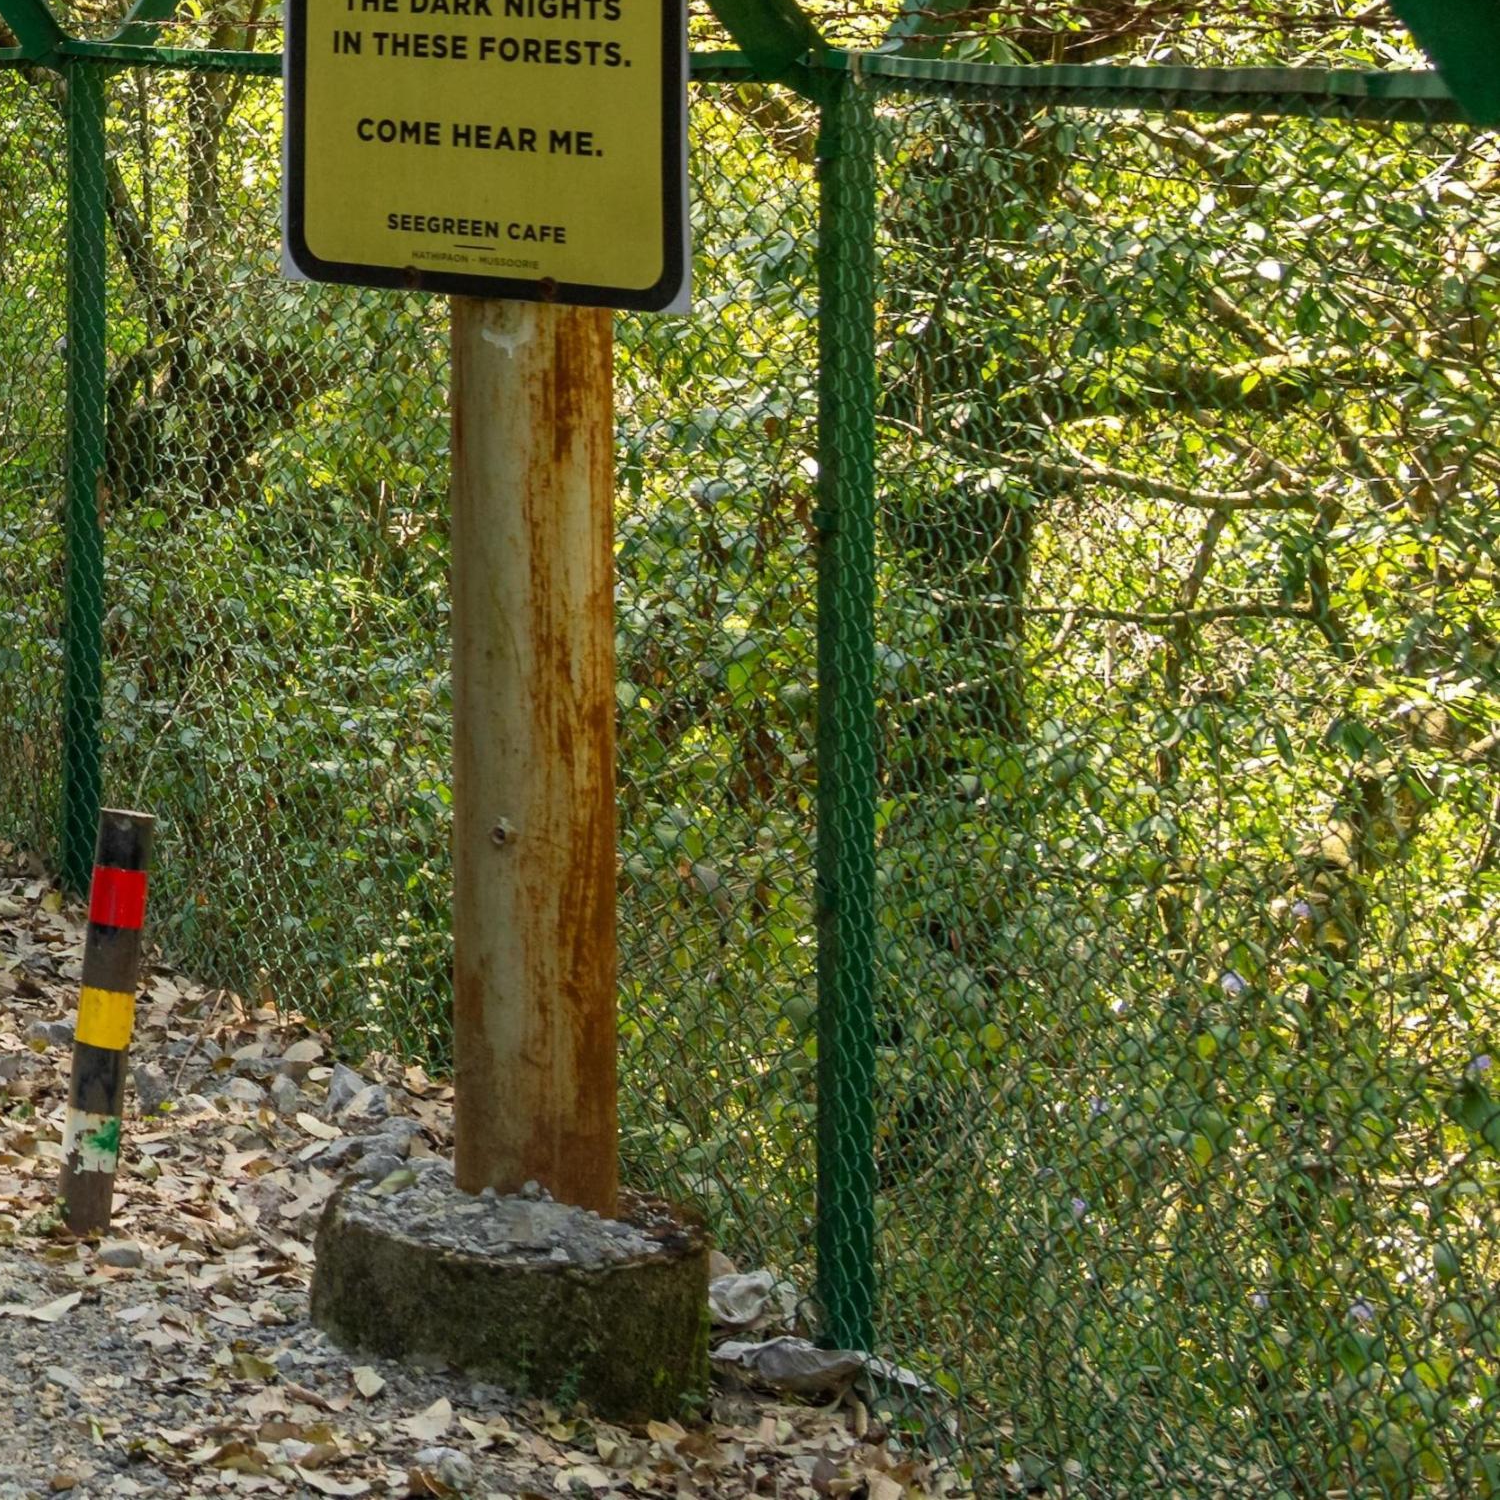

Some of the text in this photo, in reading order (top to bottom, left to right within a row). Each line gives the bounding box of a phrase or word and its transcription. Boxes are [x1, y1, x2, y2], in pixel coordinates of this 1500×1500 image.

[333, 30, 632, 68] IN THESE FORESTS.
[356, 117, 604, 158] COME HEAR ME.
[387, 213, 567, 245] SEEGREEN CAFE
[479, 256, 540, 271] MUSSOORIE
